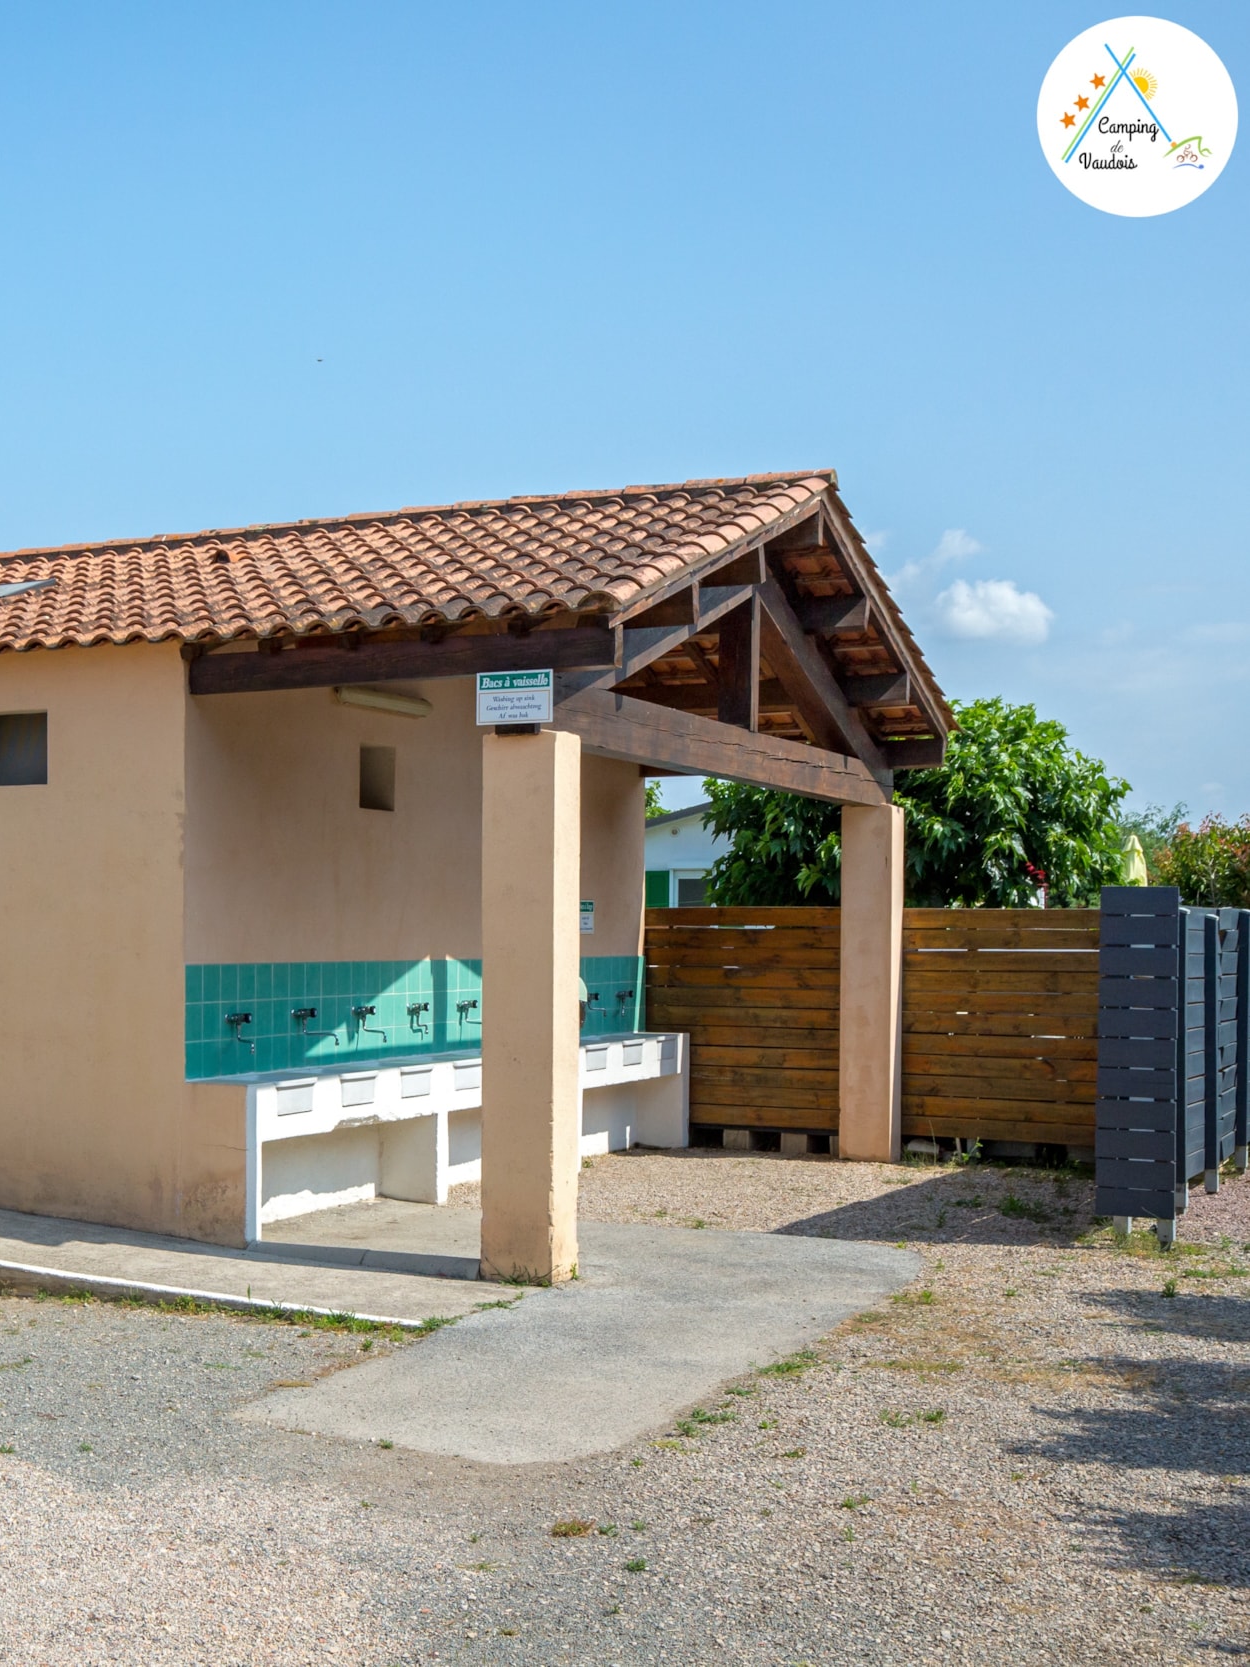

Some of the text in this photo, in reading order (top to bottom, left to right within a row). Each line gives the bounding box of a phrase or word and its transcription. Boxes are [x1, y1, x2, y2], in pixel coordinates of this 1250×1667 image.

[481, 673, 549, 689] Bacs à vaisselle
